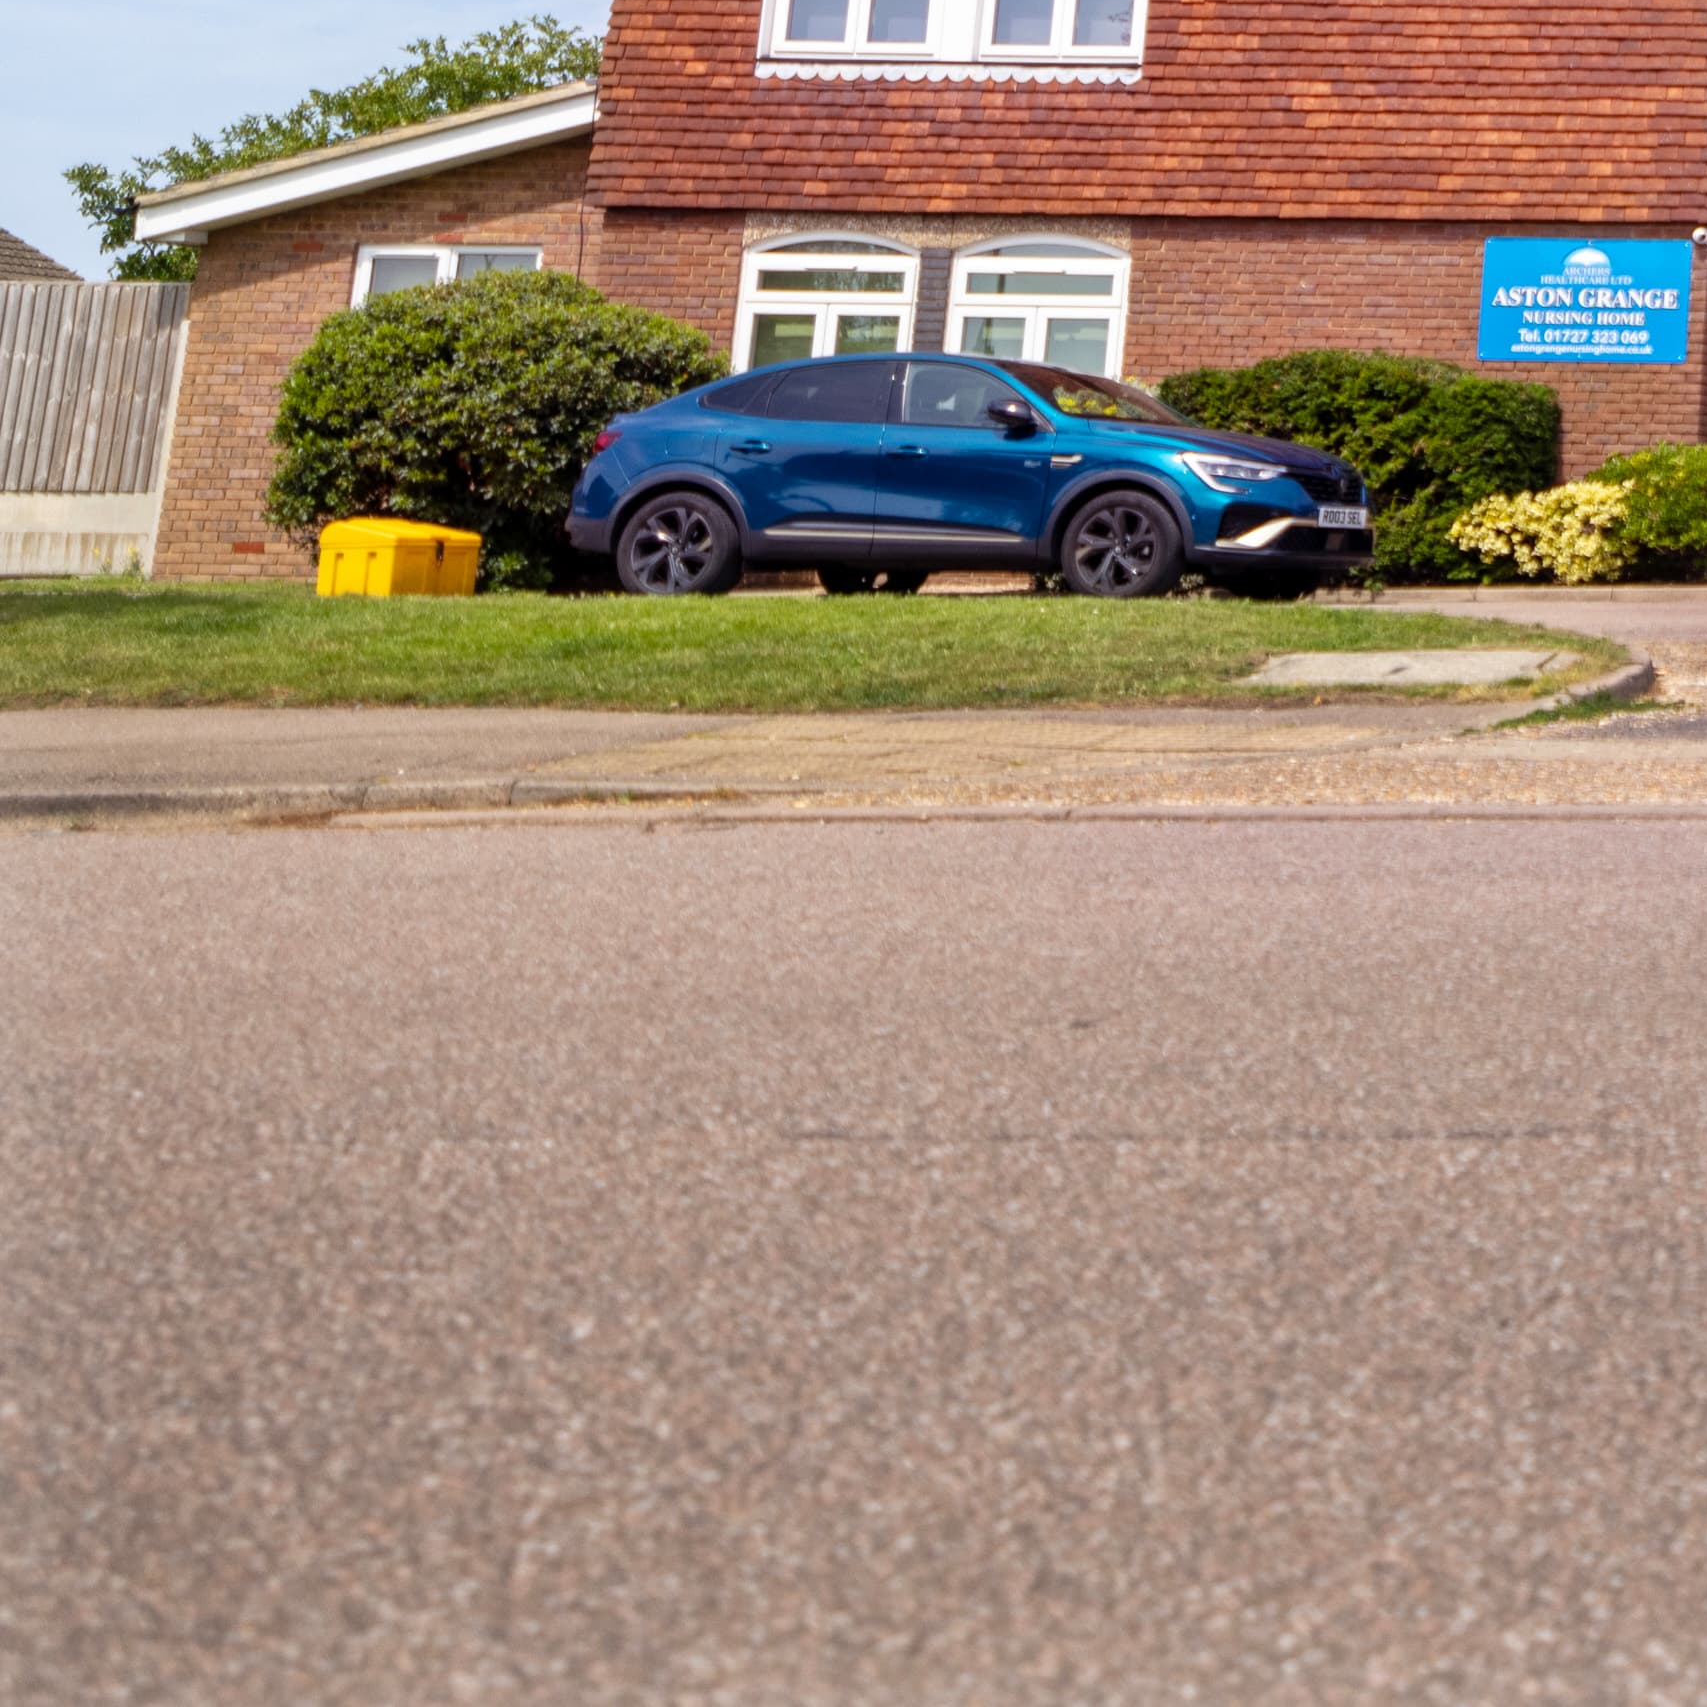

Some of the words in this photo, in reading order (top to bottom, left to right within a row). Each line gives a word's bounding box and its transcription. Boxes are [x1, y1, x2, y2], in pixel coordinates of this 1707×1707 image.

[1563, 267, 1611, 277] ARCHERS
[1540, 275, 1609, 285] HEALTHCARE
[1611, 275, 1633, 285] LTD
[1492, 286, 1573, 307] ASTON
[1578, 287, 1679, 310] GRANGE
[1522, 311, 1593, 325] NURSING
[1597, 312, 1645, 326] HOME
[1518, 328, 1541, 342] Tel.
[1543, 328, 1589, 344] 01727
[1591, 329, 1619, 344] 323
[1620, 330, 1650, 344] 069
[1511, 344, 1653, 355] astongrangenursinghome.co.uk
